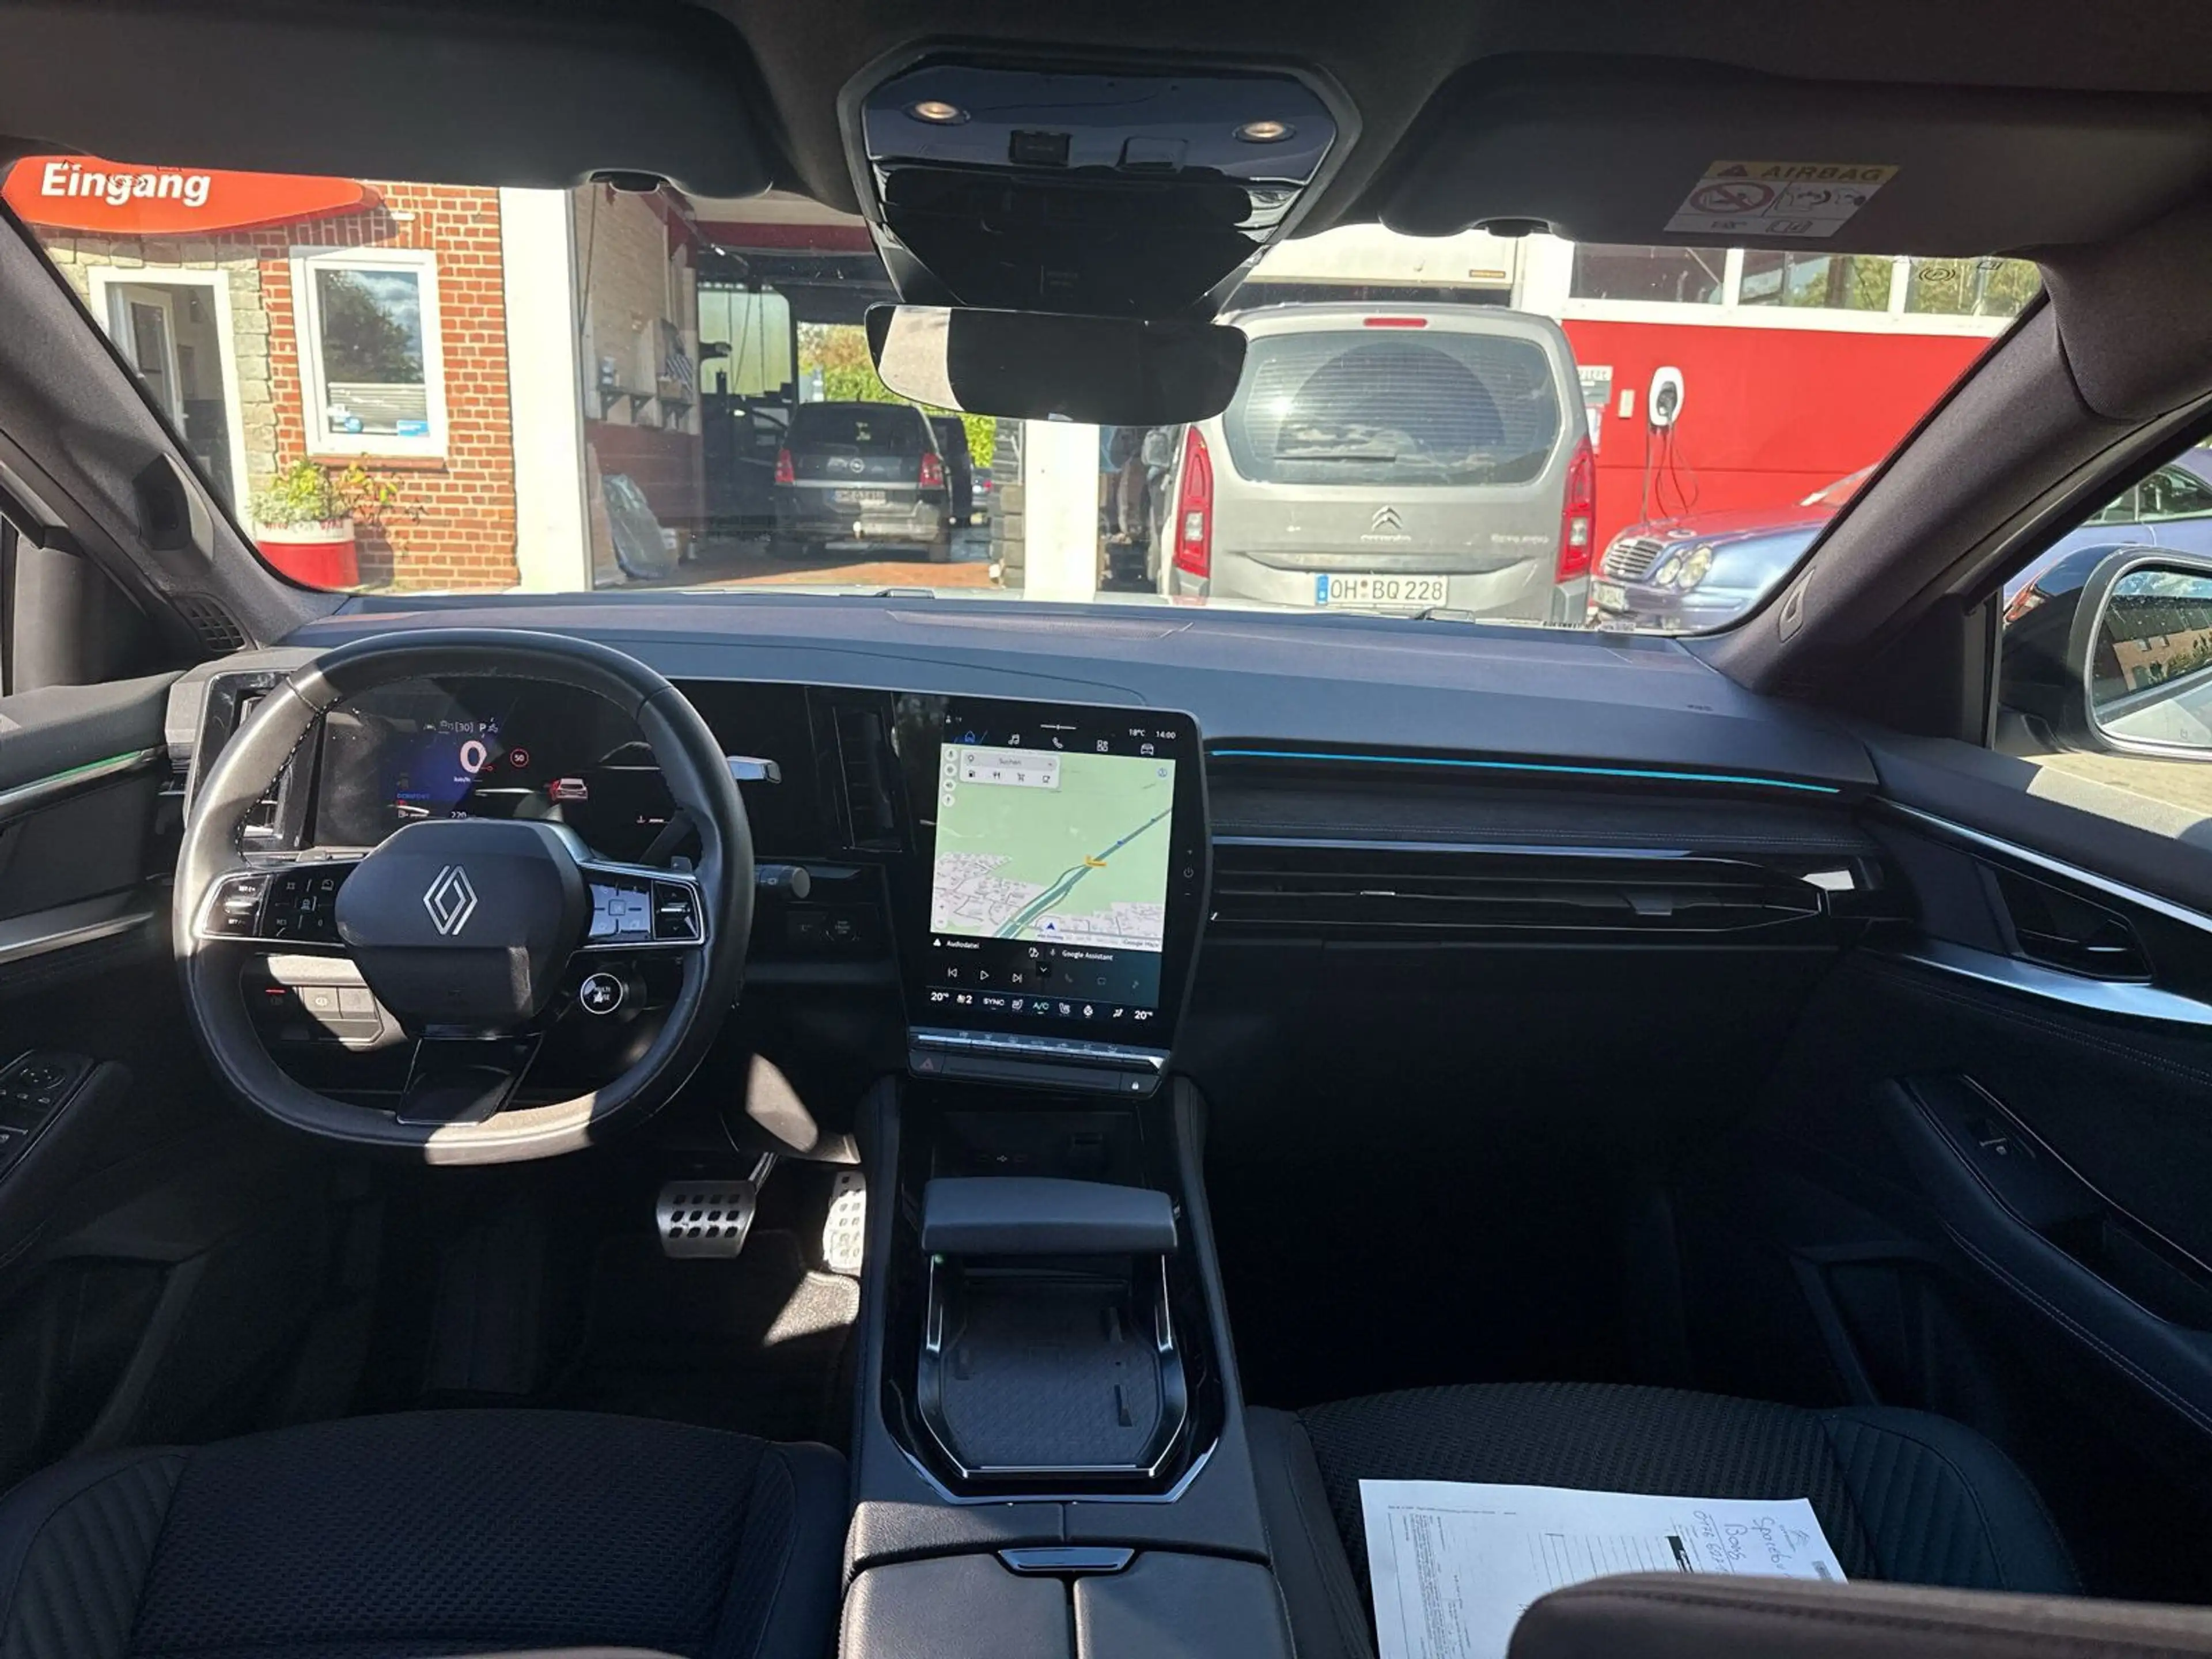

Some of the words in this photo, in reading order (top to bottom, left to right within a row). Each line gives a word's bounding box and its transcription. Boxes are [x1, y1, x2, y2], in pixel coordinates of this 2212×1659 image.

[1761, 165, 1884, 181] AIRBAG
[41, 162, 211, 207] Eingang
[1331, 581, 1357, 599] OH
[1373, 581, 1400, 599] BQ
[1404, 582, 1444, 600] 228
[460, 740, 488, 774] 0
[1062, 949, 1084, 959] Google
[1085, 952, 1113, 961] Assistant
[983, 998, 1005, 1006] SYNC
[1032, 1001, 1050, 1010] A/C
